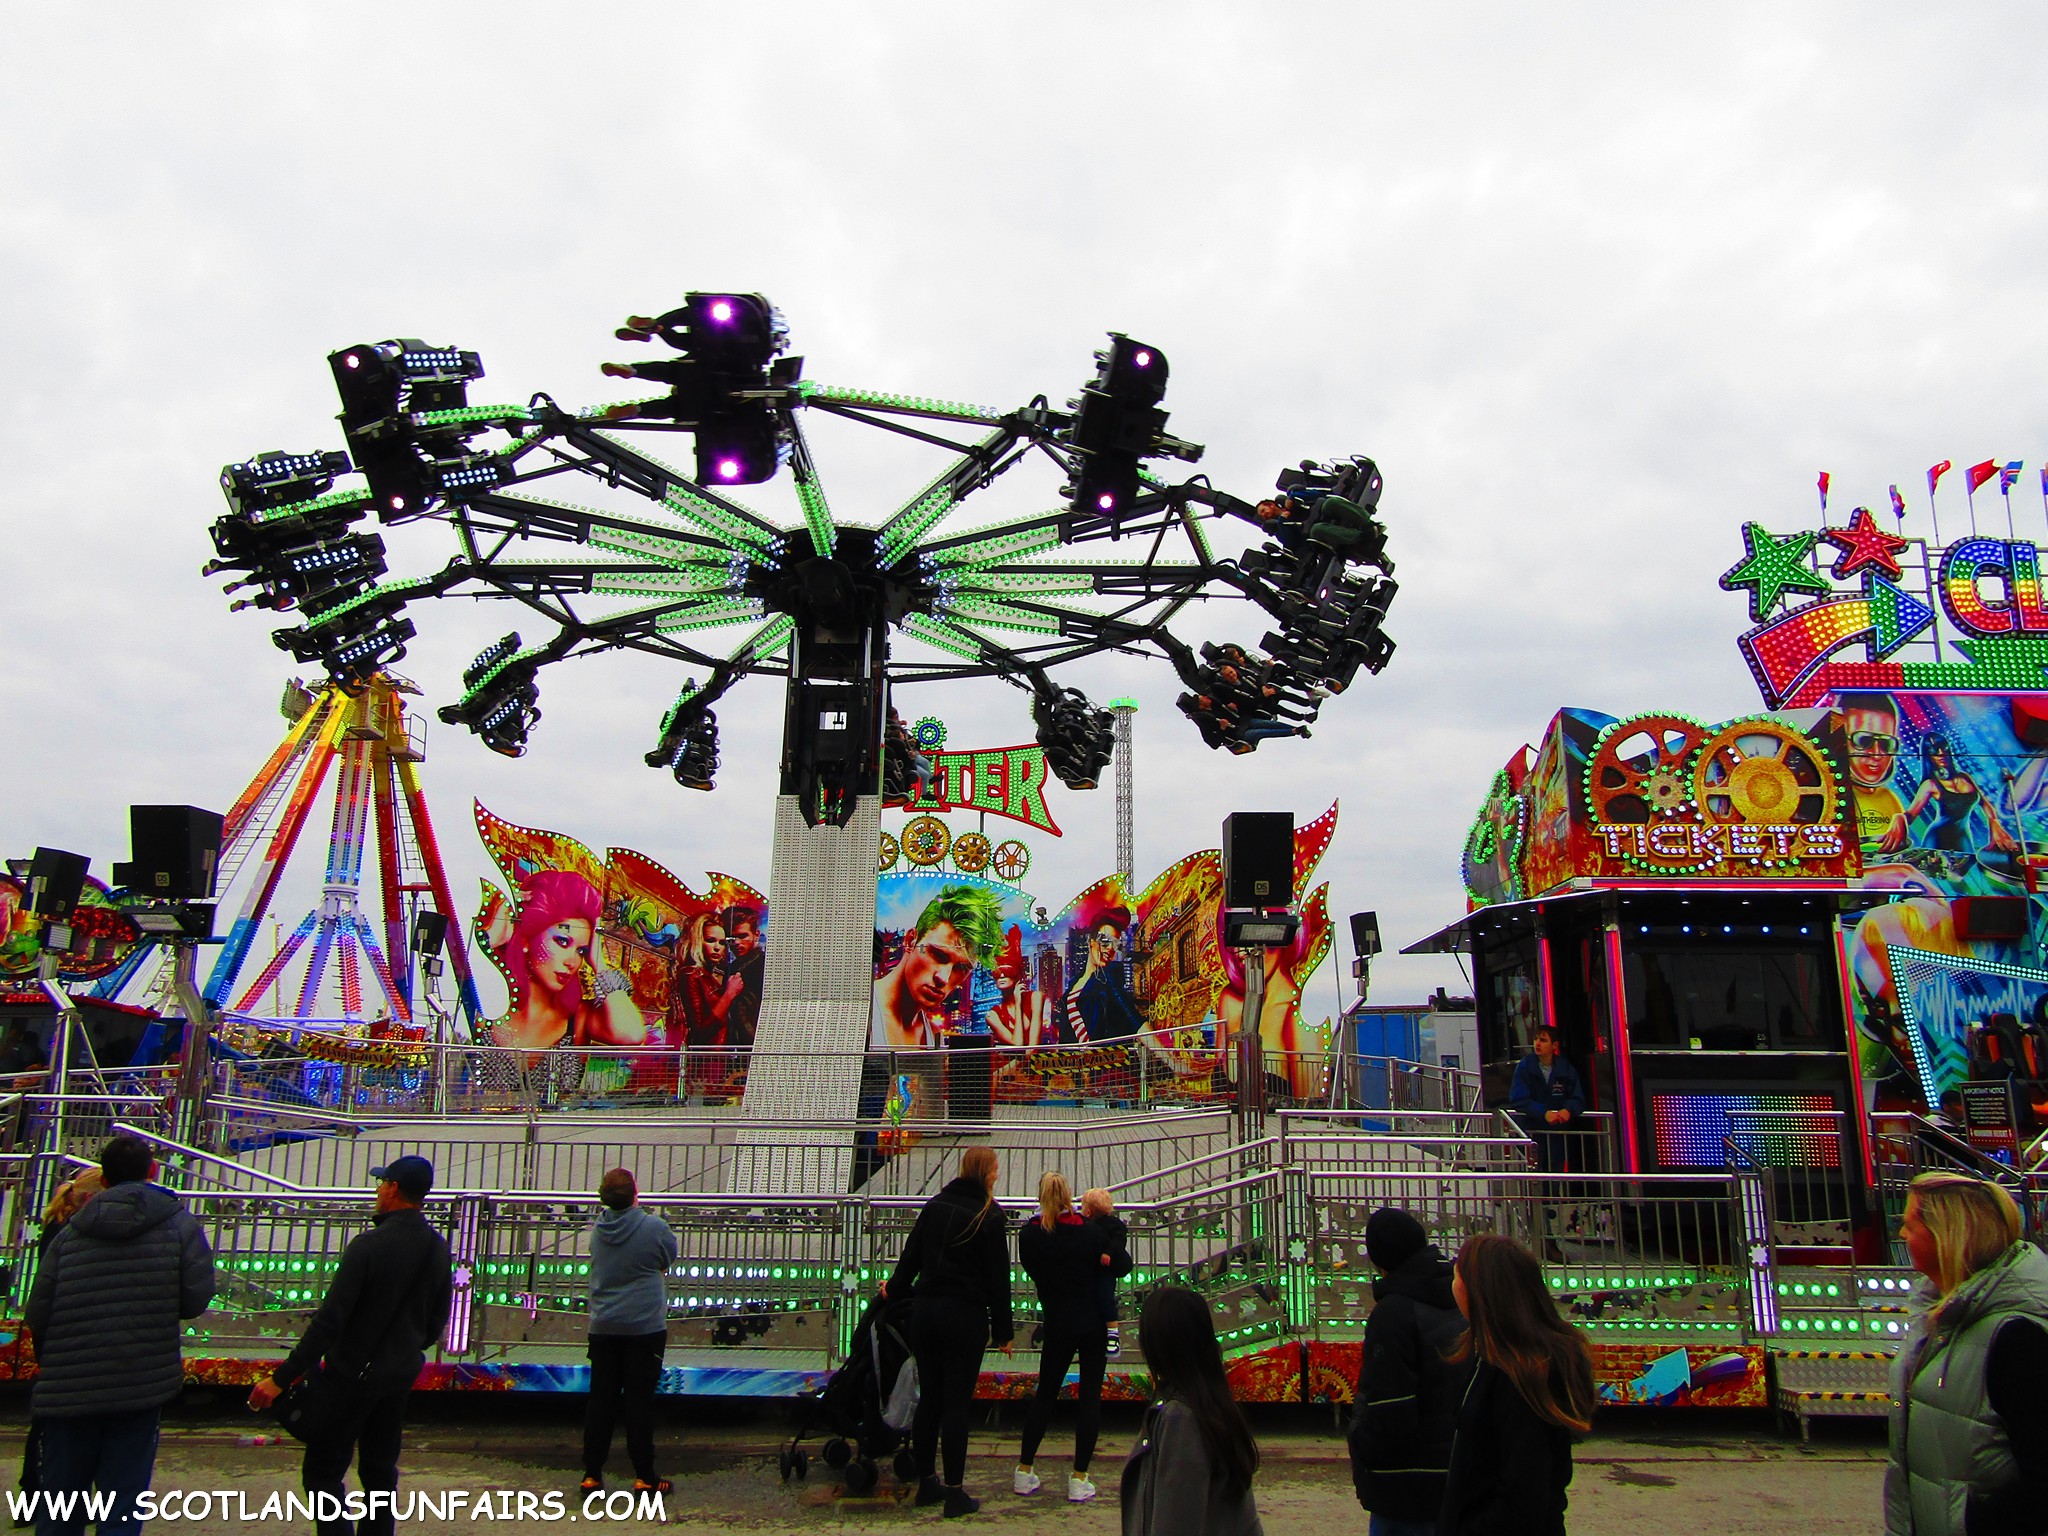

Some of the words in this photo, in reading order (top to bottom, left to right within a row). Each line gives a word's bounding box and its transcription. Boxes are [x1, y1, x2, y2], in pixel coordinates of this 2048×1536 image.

[1592, 823, 1844, 858] TICKETS
[319, 1046, 357, 1060] DANGER
[360, 1053, 385, 1062] ZONE
[1041, 1057, 1086, 1068] DANGER
[1089, 1053, 1117, 1065] ZONE
